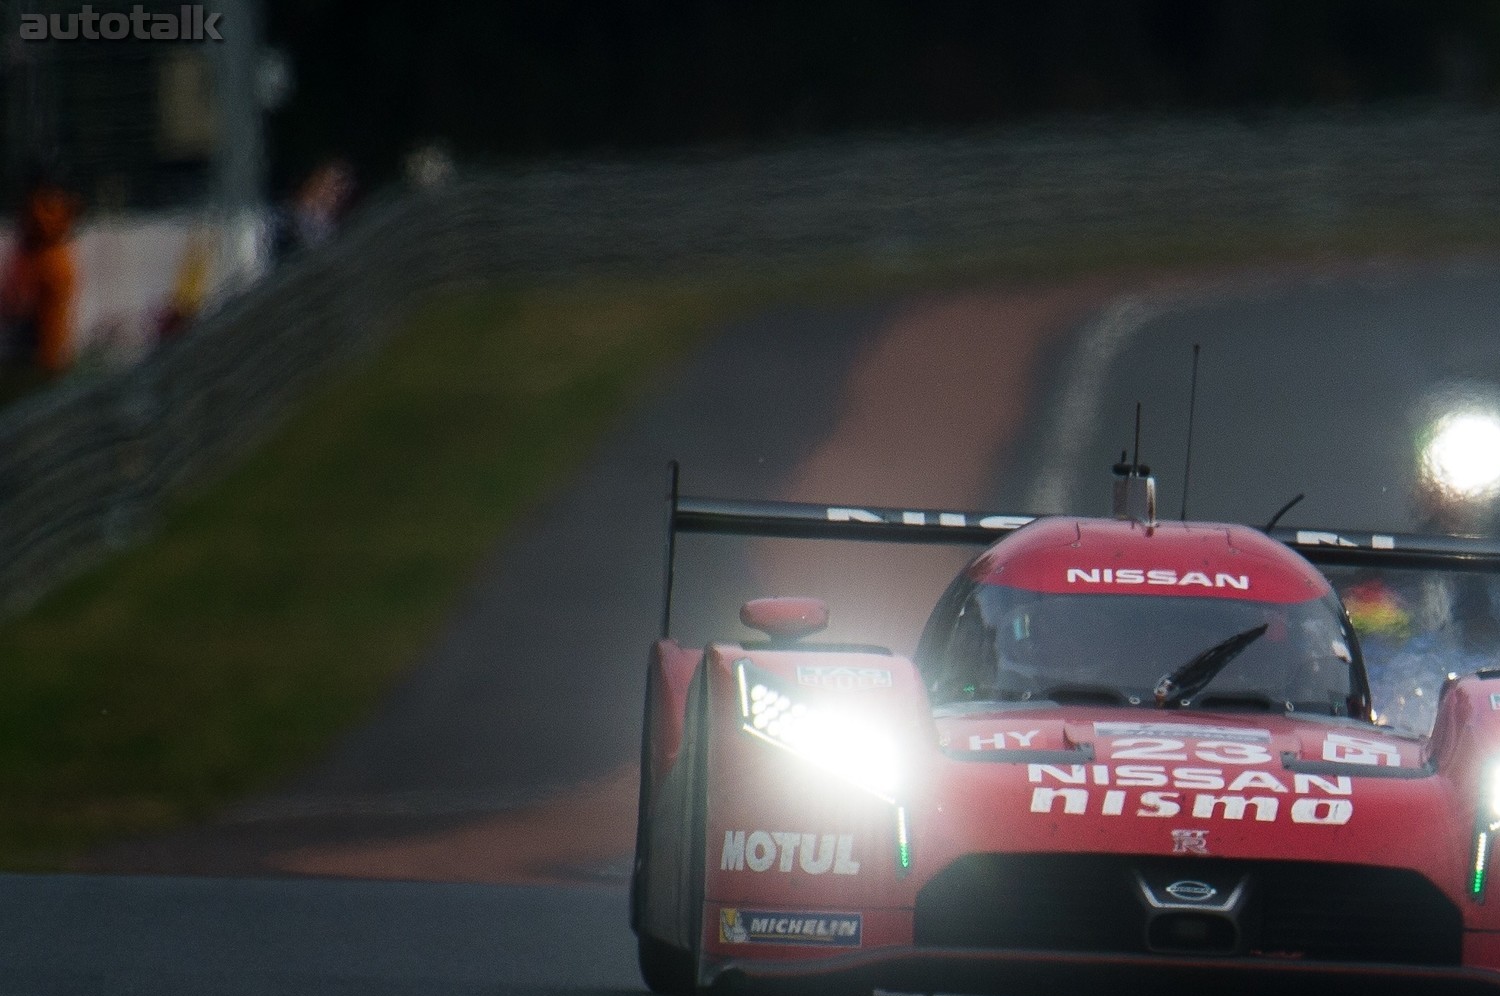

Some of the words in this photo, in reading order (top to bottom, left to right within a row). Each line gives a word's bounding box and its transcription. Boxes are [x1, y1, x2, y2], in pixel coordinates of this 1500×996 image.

[1066, 568, 1249, 590] NISSAN
[969, 730, 1040, 750] HY
[1110, 737, 1272, 765] 23
[1027, 763, 1353, 795] NISSAN
[1030, 786, 1353, 825] nismo
[720, 830, 862, 876] MOTUL
[751, 917, 858, 937] MICHELIN
